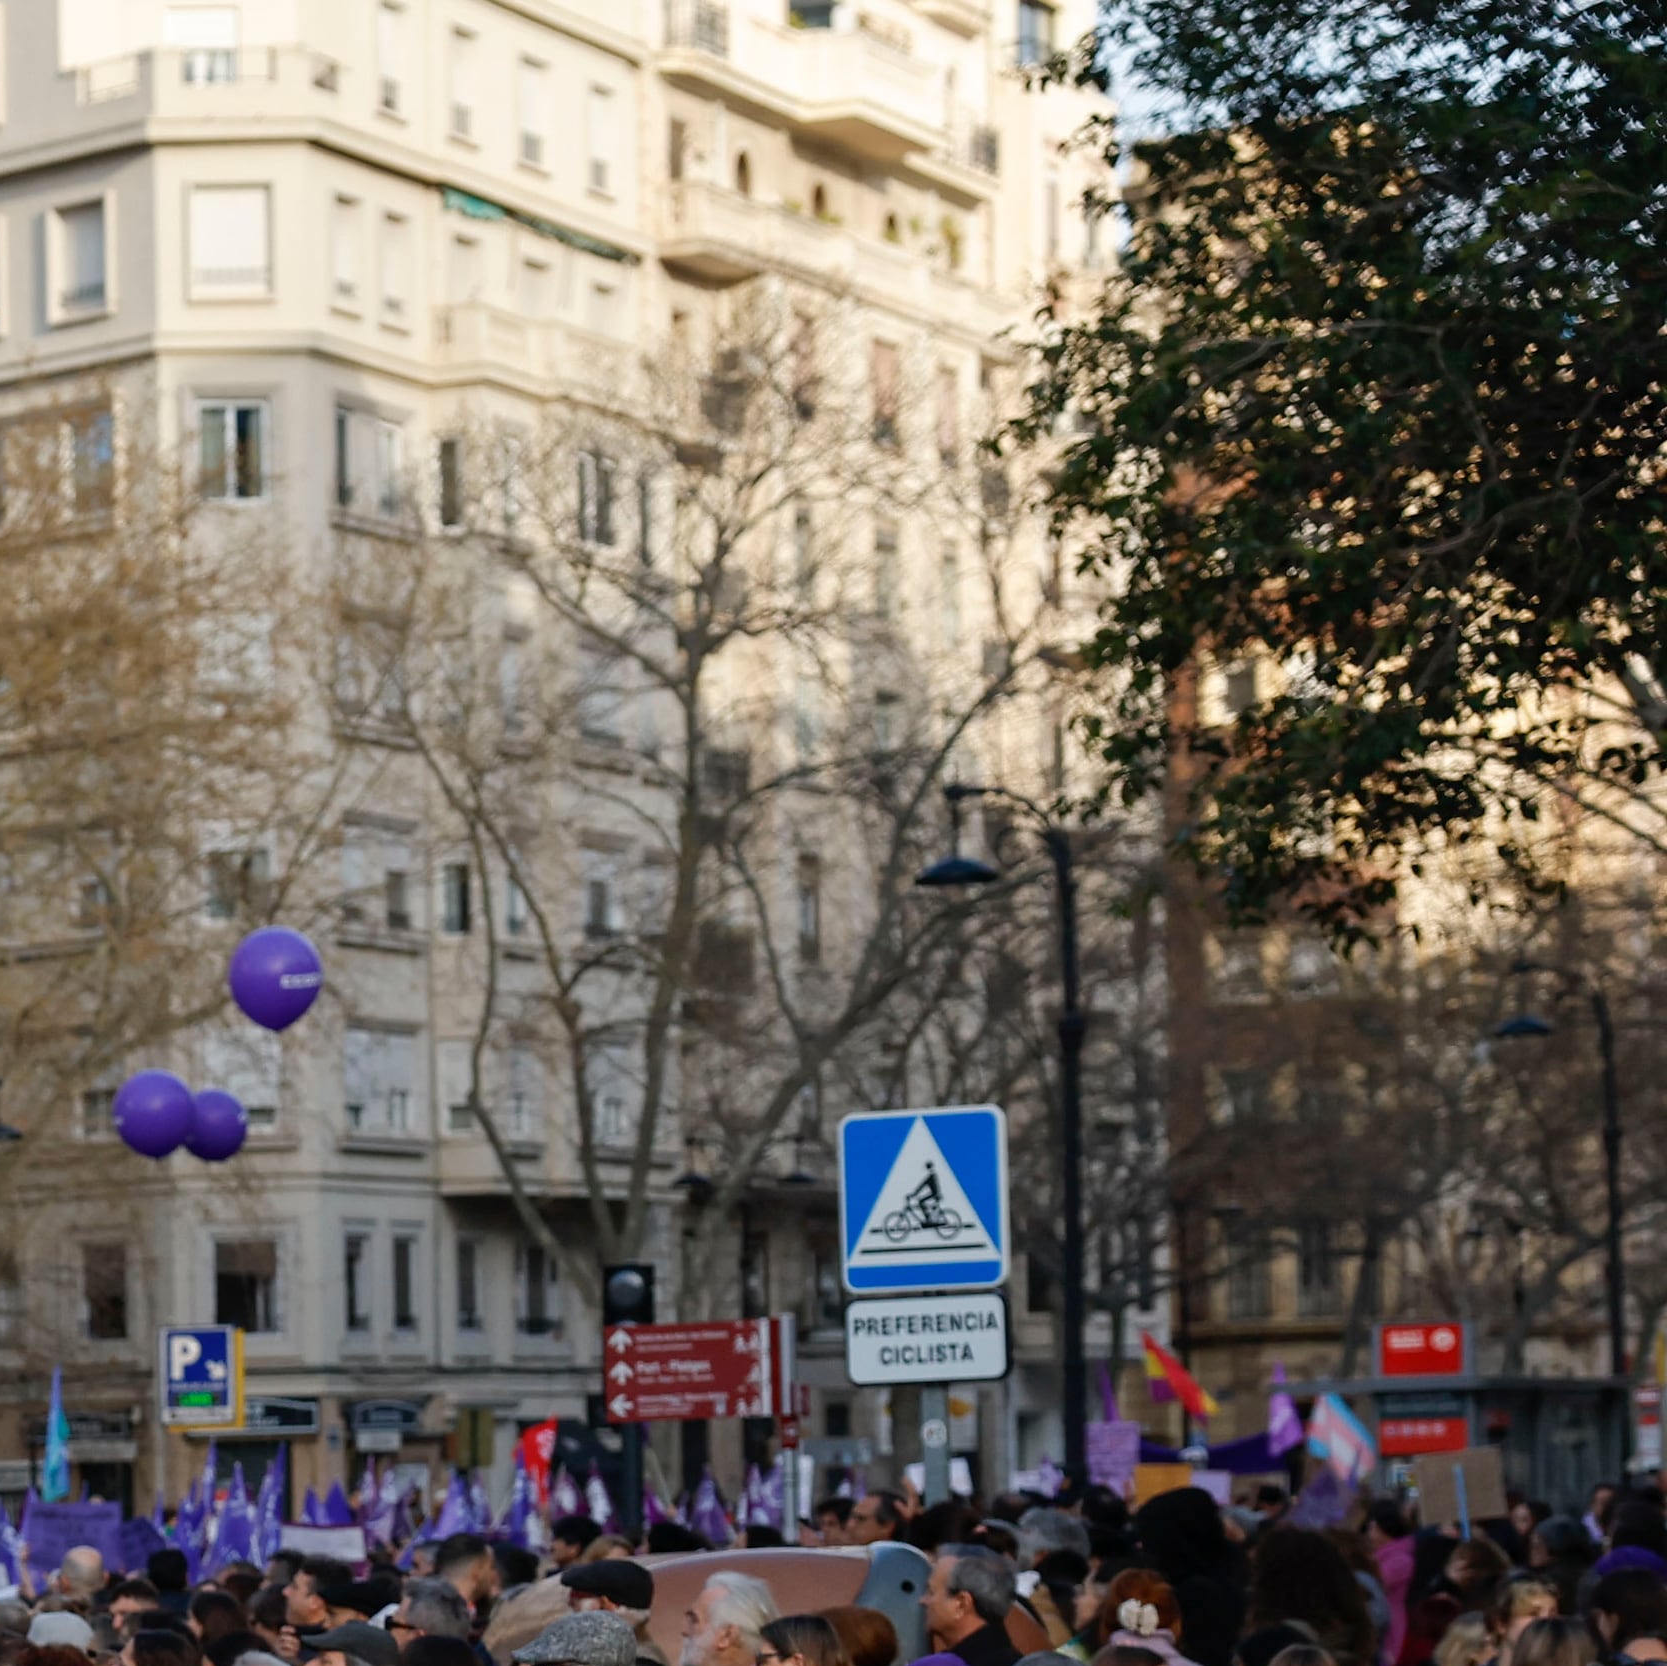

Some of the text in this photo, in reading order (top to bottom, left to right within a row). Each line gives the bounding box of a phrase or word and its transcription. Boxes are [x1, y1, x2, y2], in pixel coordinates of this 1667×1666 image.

[853, 1312, 999, 1336] PREFERENCIA
[169, 1335, 202, 1381] P
[880, 1343, 975, 1366] CICLISTA
